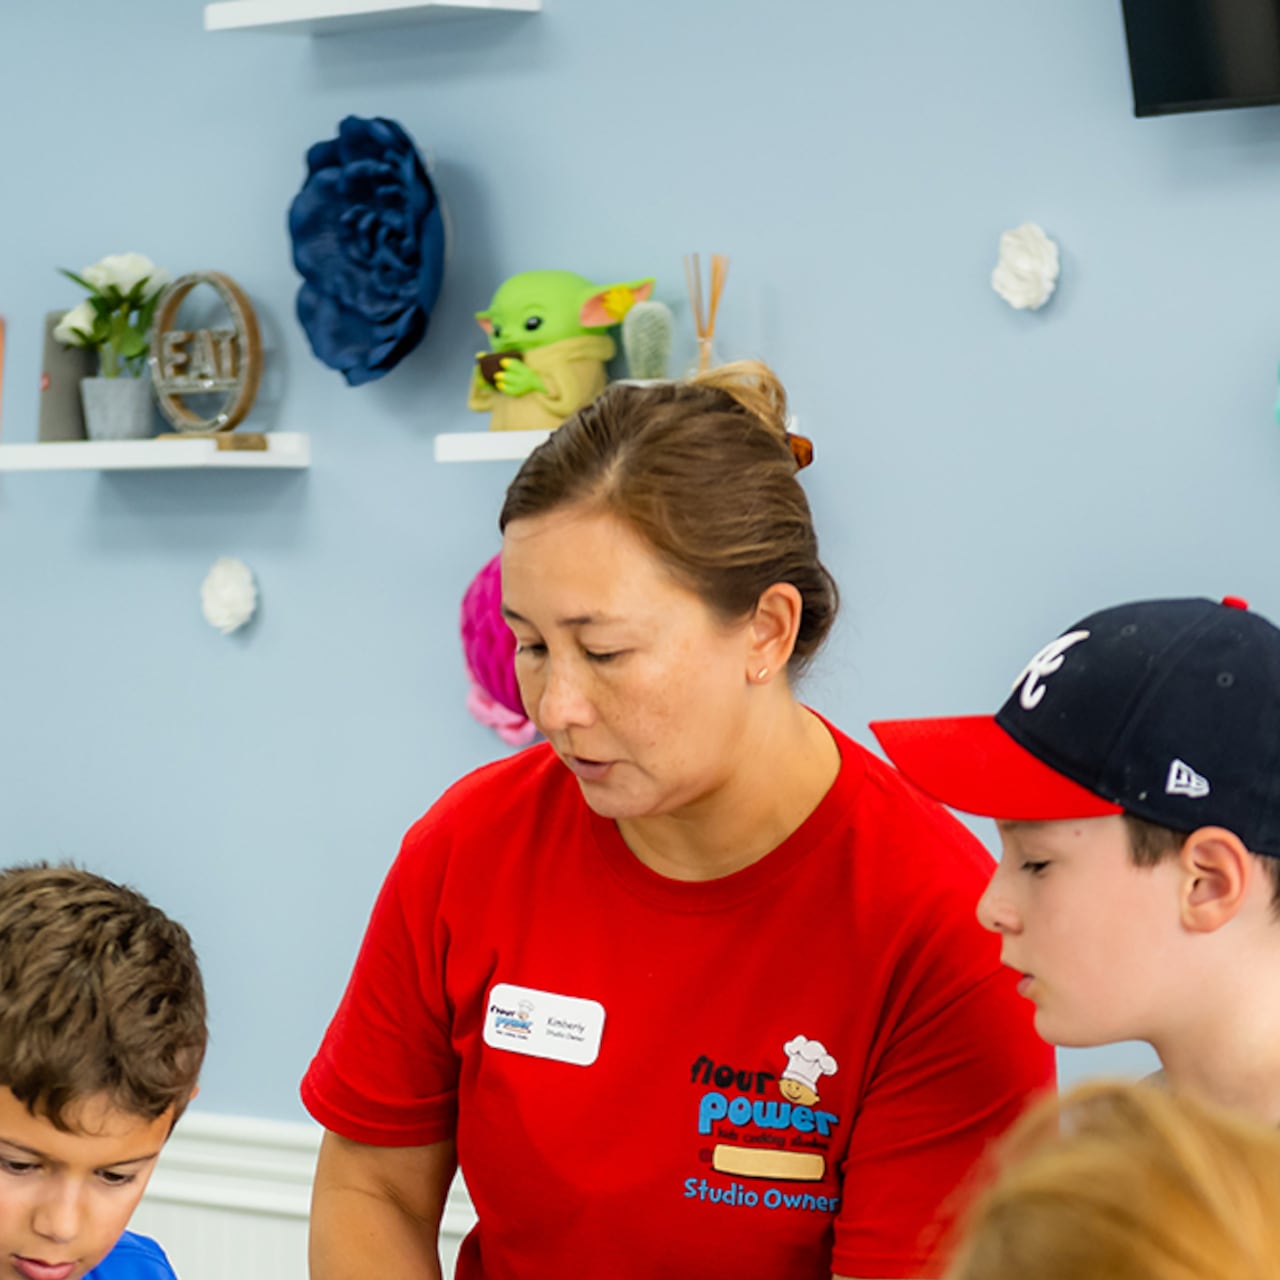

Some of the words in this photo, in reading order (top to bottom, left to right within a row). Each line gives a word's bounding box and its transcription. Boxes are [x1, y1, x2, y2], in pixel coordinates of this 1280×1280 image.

[163, 330, 237, 381] EAT
[690, 1054, 775, 1095] flour
[698, 1091, 840, 1137] power
[683, 1177, 759, 1208] Studio
[763, 1188, 840, 1212] Owner
